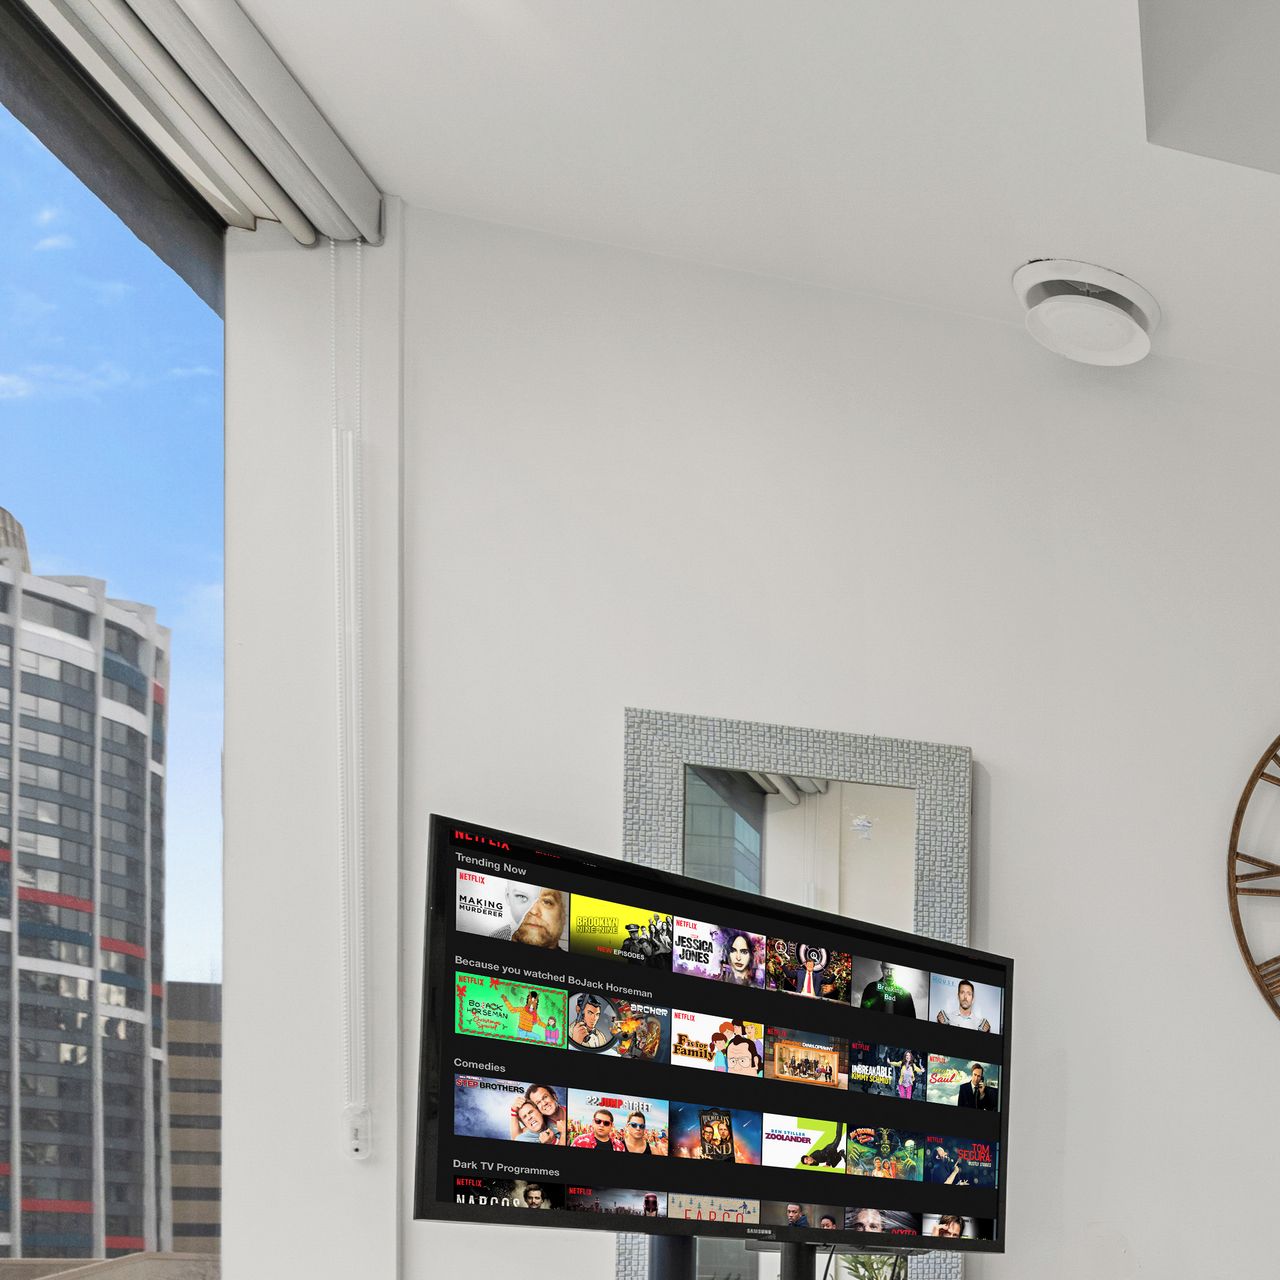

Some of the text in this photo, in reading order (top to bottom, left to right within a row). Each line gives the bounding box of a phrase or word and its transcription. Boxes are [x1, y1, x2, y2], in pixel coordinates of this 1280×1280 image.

[455, 852, 527, 876] Trending Now
[459, 872, 485, 885] NETFLIX
[459, 895, 503, 910] MAKING
[459, 904, 503, 918] MURDERER
[576, 916, 619, 927] BROOKLYN
[676, 919, 697, 930] NETFLIX
[576, 926, 619, 935] NINE-NINE
[675, 935, 714, 954] JESSICA
[613, 949, 645, 960] EPISODES
[679, 948, 710, 964] JONES
[455, 955, 653, 999] Because you watched BoJack Horseman
[458, 976, 484, 986] NETFLIX
[884, 993, 896, 1002] Bad
[467, 1008, 508, 1020] HORSEMAN
[674, 1012, 696, 1022] NETFLIX
[677, 1033, 688, 1045] F
[695, 1041, 708, 1049] for
[672, 1044, 715, 1061] Family
[454, 1058, 506, 1073] Comedies
[851, 1065, 892, 1077] UNBREAKABLE
[851, 1072, 892, 1085] KIMMY SCHMIDT
[930, 1073, 956, 1084] Saul
[456, 1080, 478, 1088] STEP
[480, 1082, 525, 1094] BROTHERS
[600, 1097, 623, 1109] JUMP
[622, 1100, 652, 1112] STREET
[765, 1133, 811, 1144] ZOOLANDER
[705, 1142, 731, 1155] END
[972, 1143, 990, 1154] TOM
[453, 1160, 560, 1177] Dark TV Programmes
[456, 1178, 482, 1187] NETFLIX
[568, 1187, 592, 1196] NETFLIX
